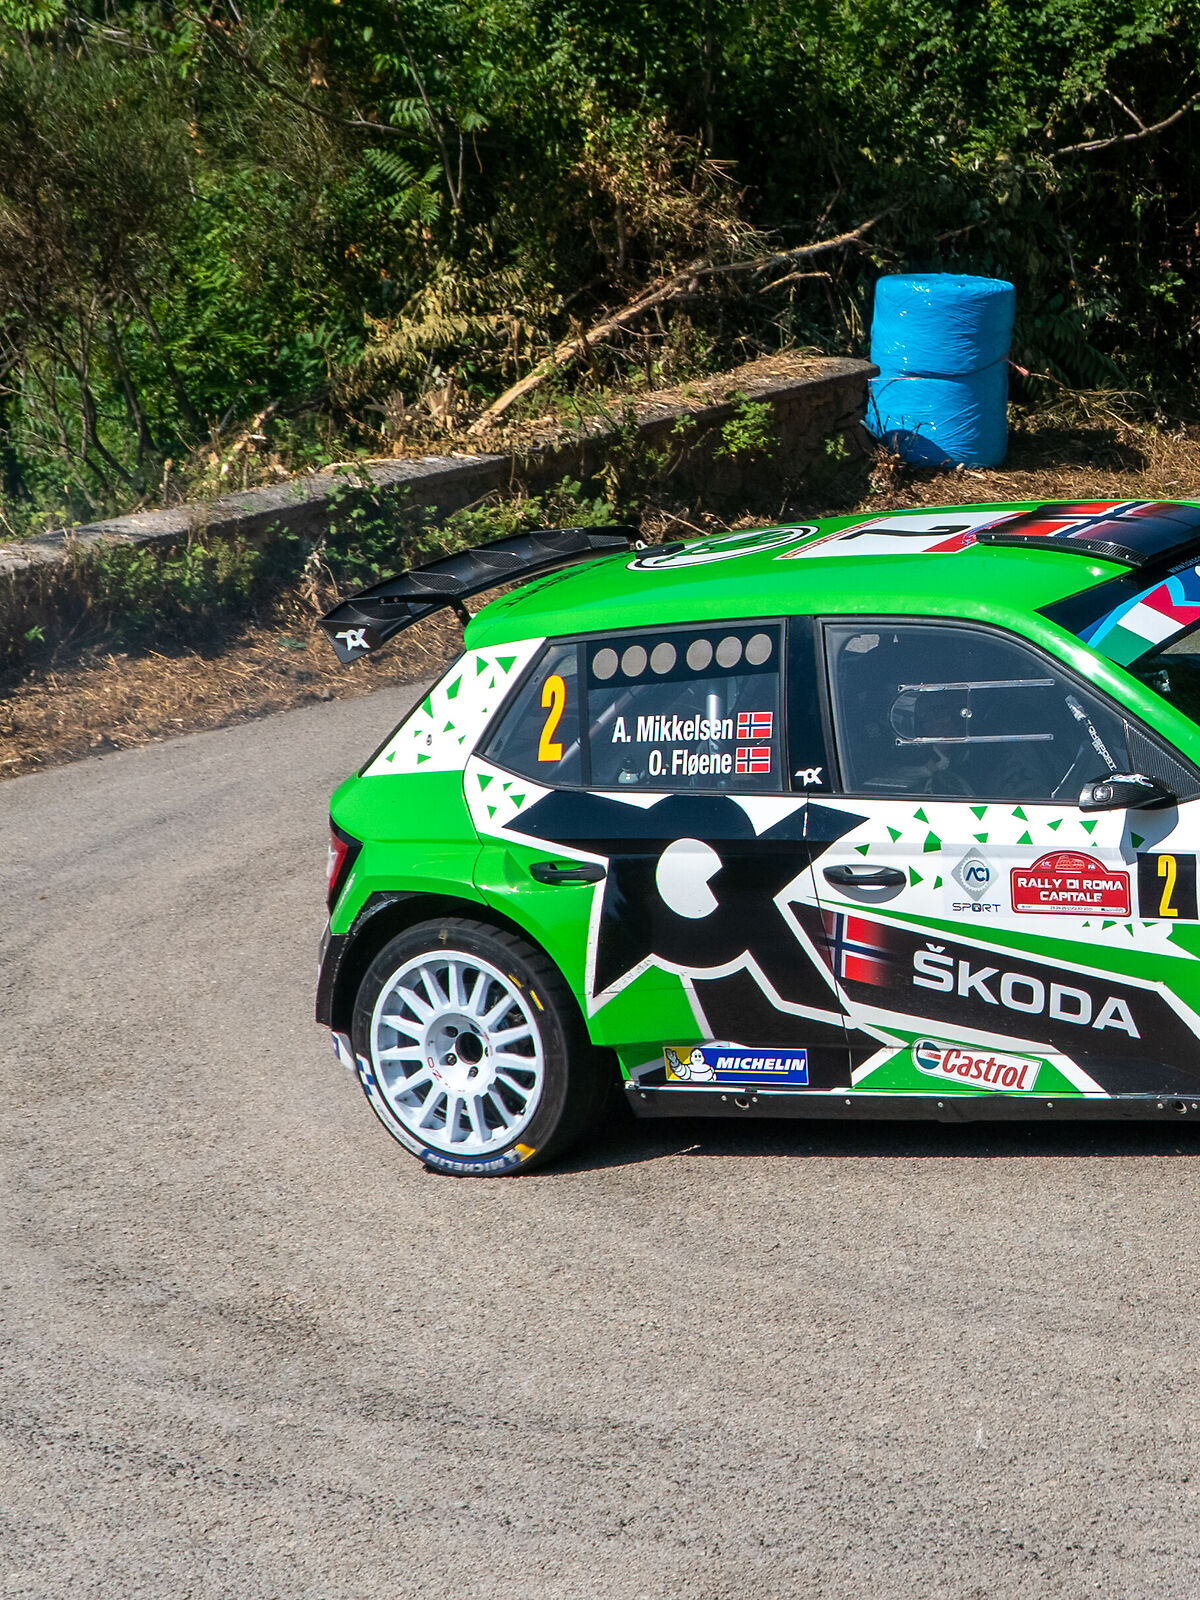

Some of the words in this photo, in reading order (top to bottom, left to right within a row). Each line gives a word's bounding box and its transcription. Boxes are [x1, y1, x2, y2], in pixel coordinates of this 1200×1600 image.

[538, 674, 566, 762] 2
[611, 716, 631, 743] A.
[636, 714, 734, 743] Mikkelsen
[648, 749, 667, 776] O.
[671, 749, 732, 777] Fløene
[965, 867, 990, 882] ACI
[1017, 877, 1063, 889] RALLY
[1083, 880, 1123, 891] ROMA
[1157, 854, 1178, 917] 2
[952, 903, 1001, 913] SPORT
[1039, 891, 1102, 903] CAPITALE
[912, 942, 1141, 1040] ŠKODA
[716, 1056, 806, 1071] MICHELIN
[941, 1048, 1029, 1090] Castrol
[426, 1152, 506, 1173] MICHELIN
